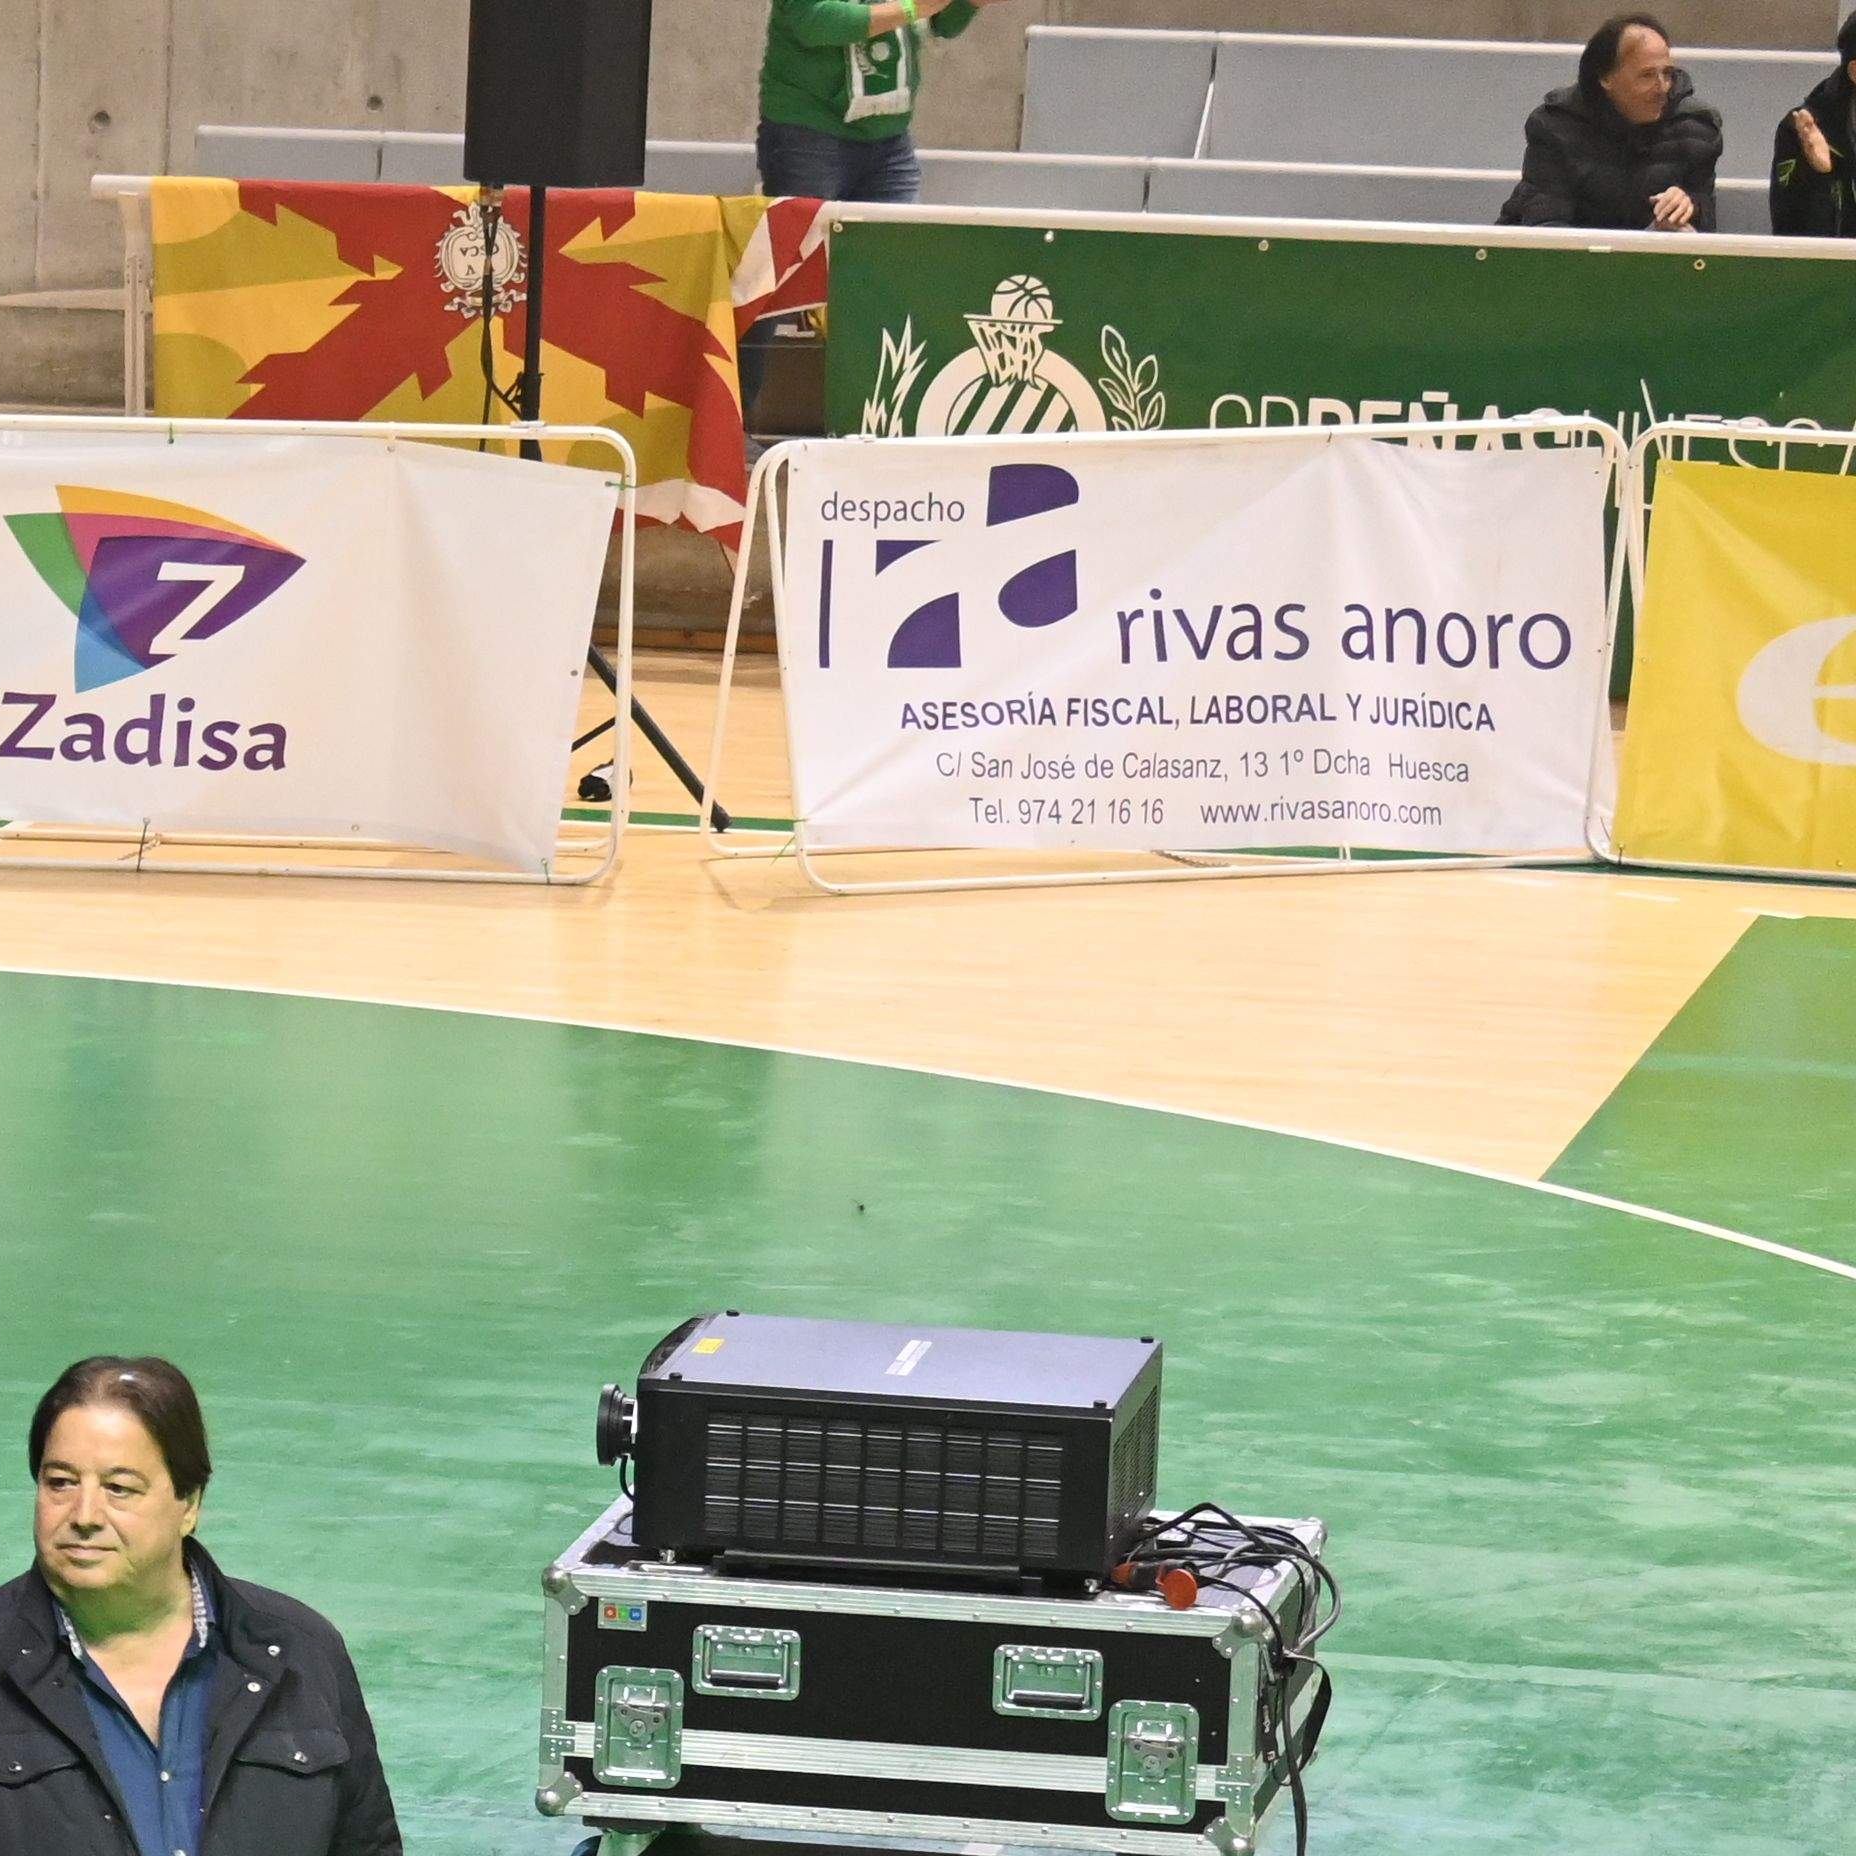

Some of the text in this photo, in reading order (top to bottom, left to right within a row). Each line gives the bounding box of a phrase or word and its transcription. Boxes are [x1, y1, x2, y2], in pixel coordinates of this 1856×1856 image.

[821, 491, 965, 529] despacho
[1117, 588, 1572, 670] rivas anoro
[900, 691, 1496, 732] ASESORÍA FISCAL, LABORAL Y JURÍDICA
[936, 752, 962, 778] C/
[971, 751, 1014, 779] San
[1020, 752, 1076, 780] José
[1084, 753, 1114, 779] de
[1122, 752, 1228, 782] Calasanz,
[1239, 751, 1269, 778] 13
[1313, 748, 1370, 776] Dcha
[1388, 753, 1470, 782] Huesca
[969, 795, 1443, 826] Tel. 974 21 16 16 www.rivasanoro.com
